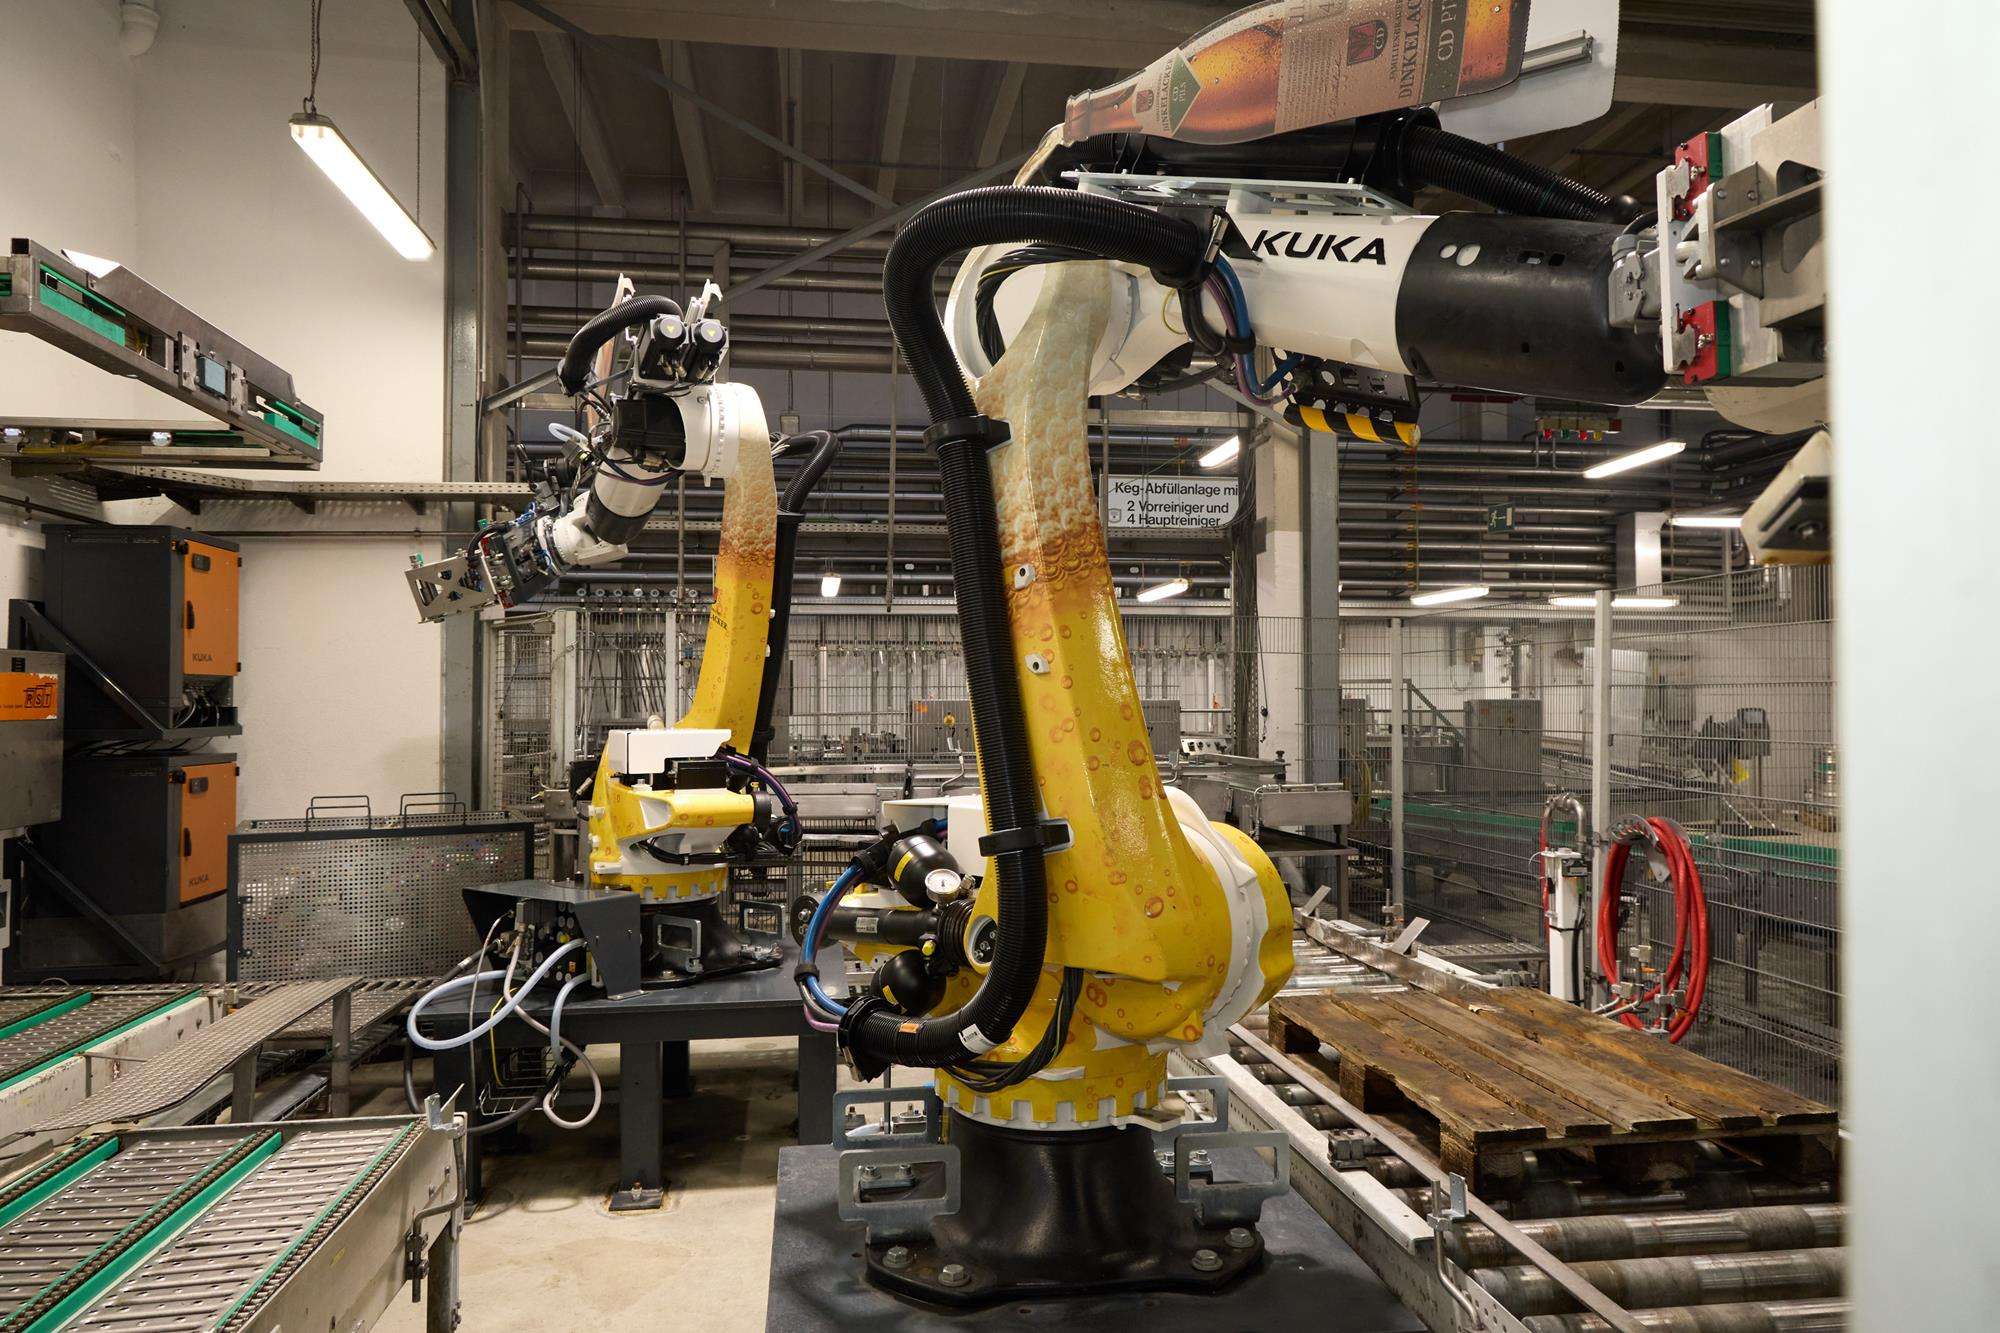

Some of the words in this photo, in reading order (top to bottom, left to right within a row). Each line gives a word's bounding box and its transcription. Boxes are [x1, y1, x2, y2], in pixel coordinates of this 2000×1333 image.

[1440, 0, 1457, 23] PI
[1376, 27, 1385, 50] CD
[1437, 29, 1455, 61] CD
[1250, 229, 1387, 265] KUKA
[1115, 482, 1221, 497] Keg-Abfüllanlage
[1223, 484, 1241, 496] mi
[1127, 500, 1135, 512] 2
[1138, 500, 1206, 516] Vorreiniger
[1206, 502, 1229, 514] und
[1127, 513, 1136, 525] 4
[1139, 513, 1221, 528] Hauptreiniger
[711, 613, 728, 631] ACKER
[192, 652, 213, 662] KUKA
[24, 691, 53, 708] RST
[188, 873, 209, 887] KUKA
